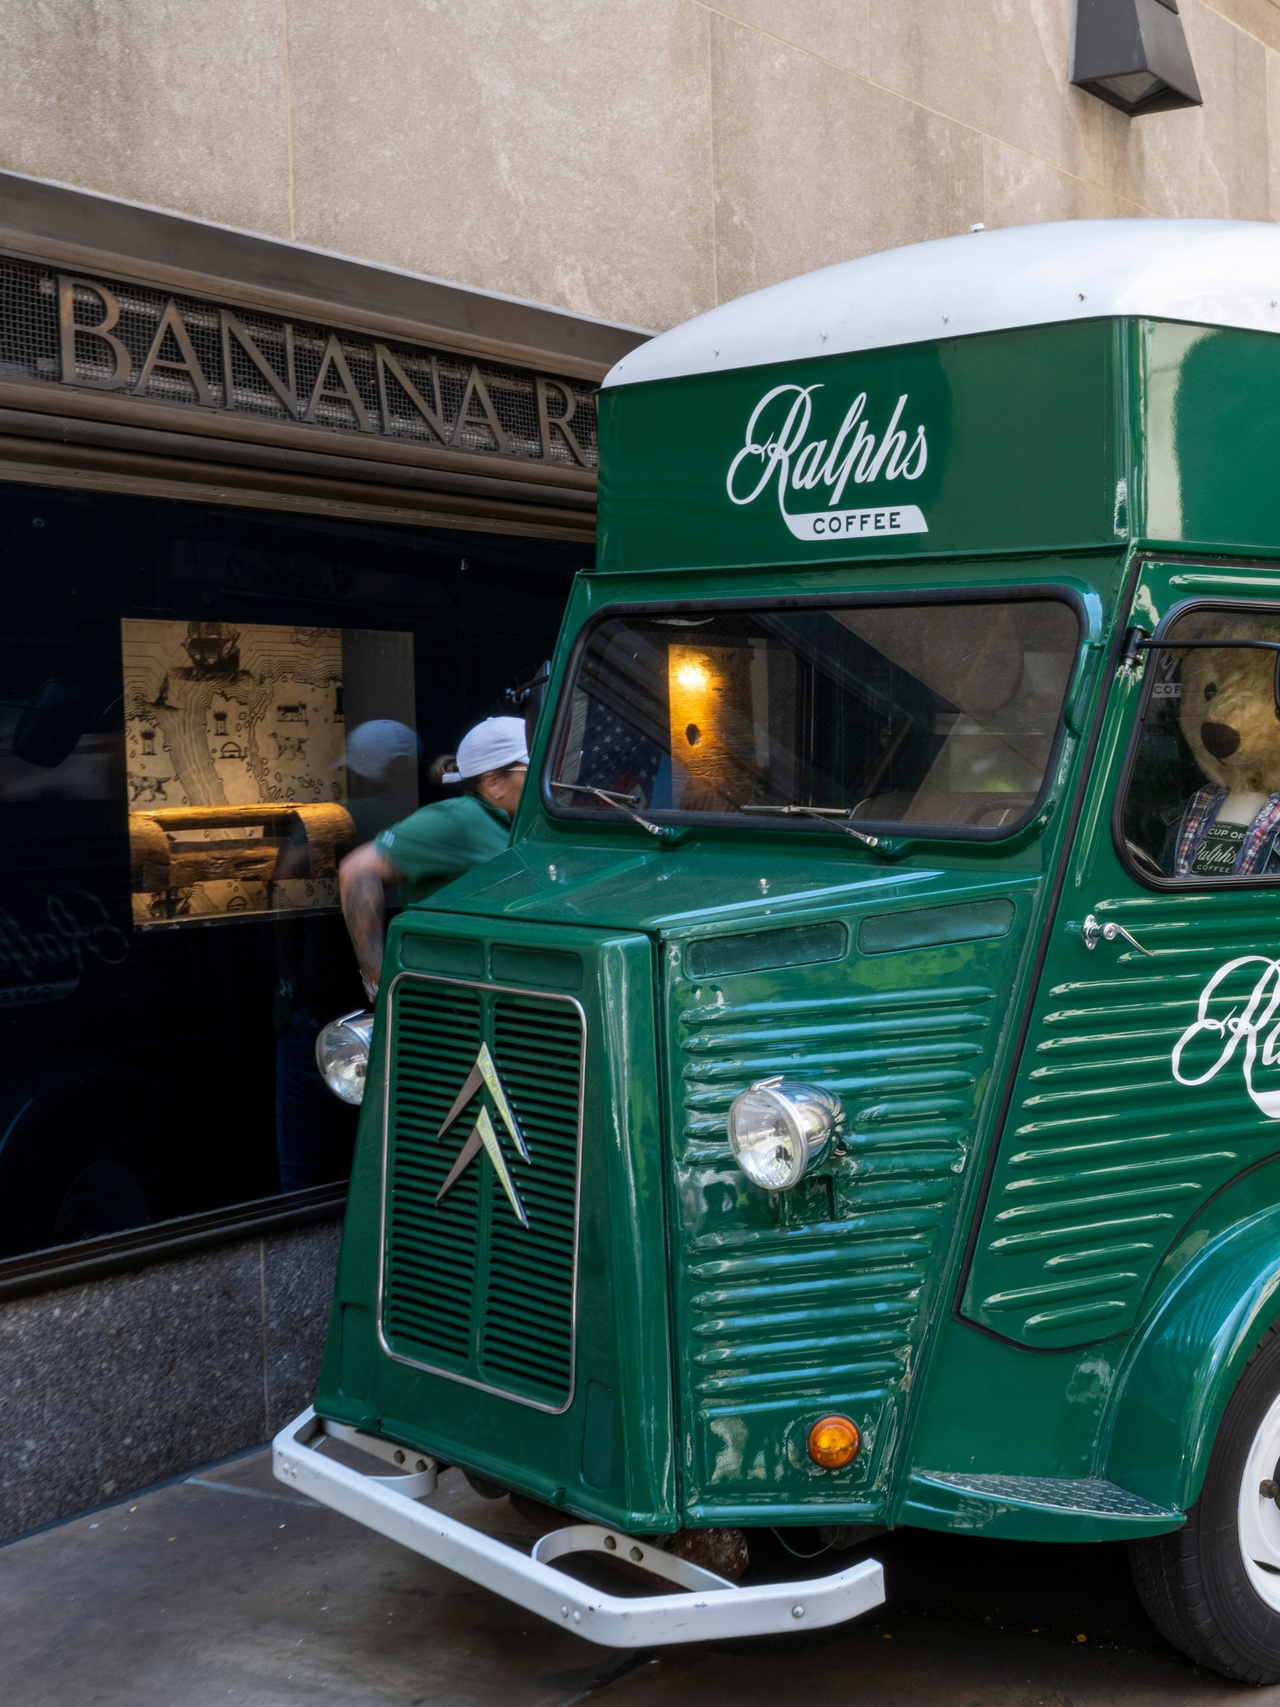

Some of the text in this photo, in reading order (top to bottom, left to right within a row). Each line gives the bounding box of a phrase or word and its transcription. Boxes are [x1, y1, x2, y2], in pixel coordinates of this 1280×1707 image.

[57, 273, 597, 468] BANANA R
[726, 383, 928, 506] Ralphs
[813, 511, 901, 534] COFFEE
[1154, 685, 1182, 695] COF
[1208, 828, 1246, 840] CUP OF
[1196, 864, 1231, 874] COFFEE
